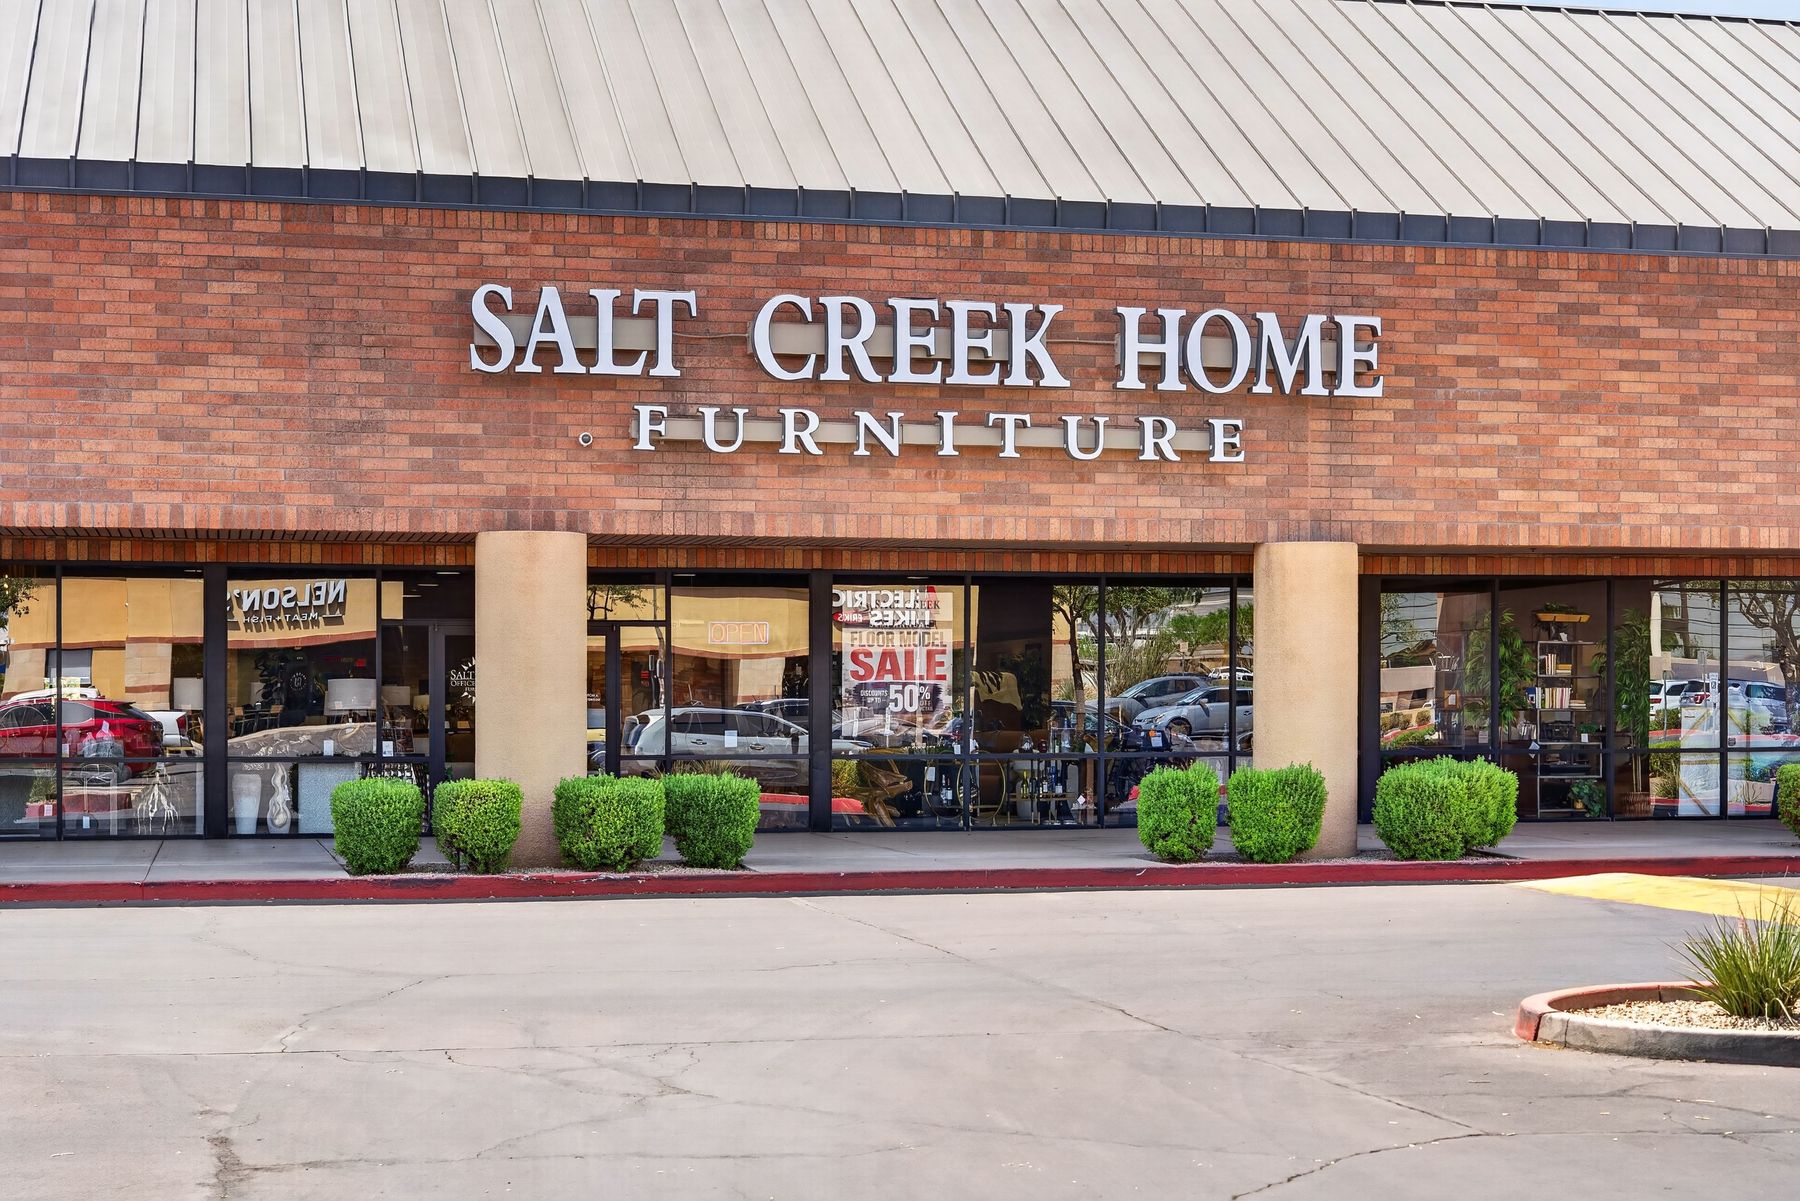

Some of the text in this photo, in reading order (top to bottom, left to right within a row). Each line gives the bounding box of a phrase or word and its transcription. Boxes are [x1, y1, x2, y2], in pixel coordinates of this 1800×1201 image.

[469, 283, 1384, 397] SALT CREEK HOME
[631, 404, 1246, 464] FURNITURE
[711, 623, 766, 642] OPEN
[850, 631, 947, 648] FLOOR MODEL
[450, 669, 475, 680] SALT
[850, 648, 947, 682] SALE
[889, 684, 931, 712] 50%
